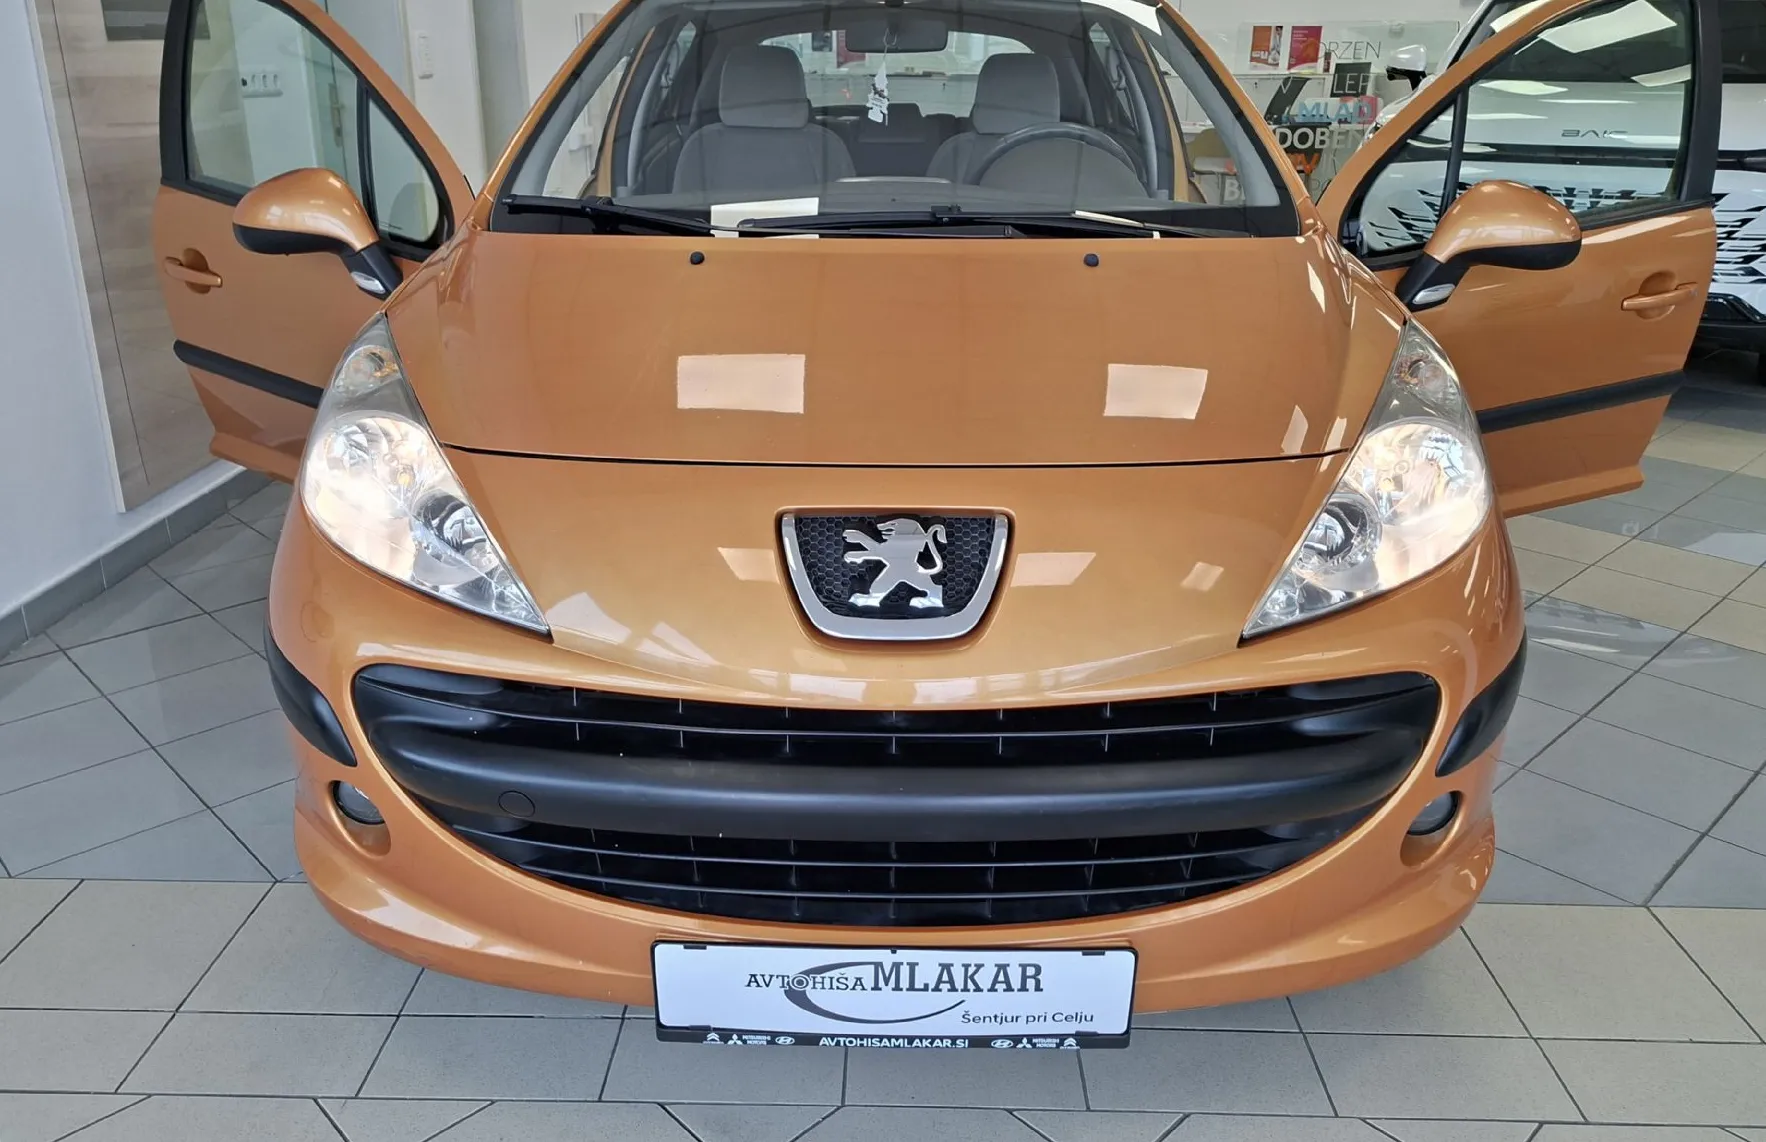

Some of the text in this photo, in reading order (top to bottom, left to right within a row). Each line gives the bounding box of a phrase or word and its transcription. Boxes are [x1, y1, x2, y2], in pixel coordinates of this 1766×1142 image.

[871, 961, 1044, 993] MLAKAR
[961, 1010, 1094, 1025] Šentjur pri Celju
[818, 1037, 969, 1049] AVTOHISAMLAKAR.SI
